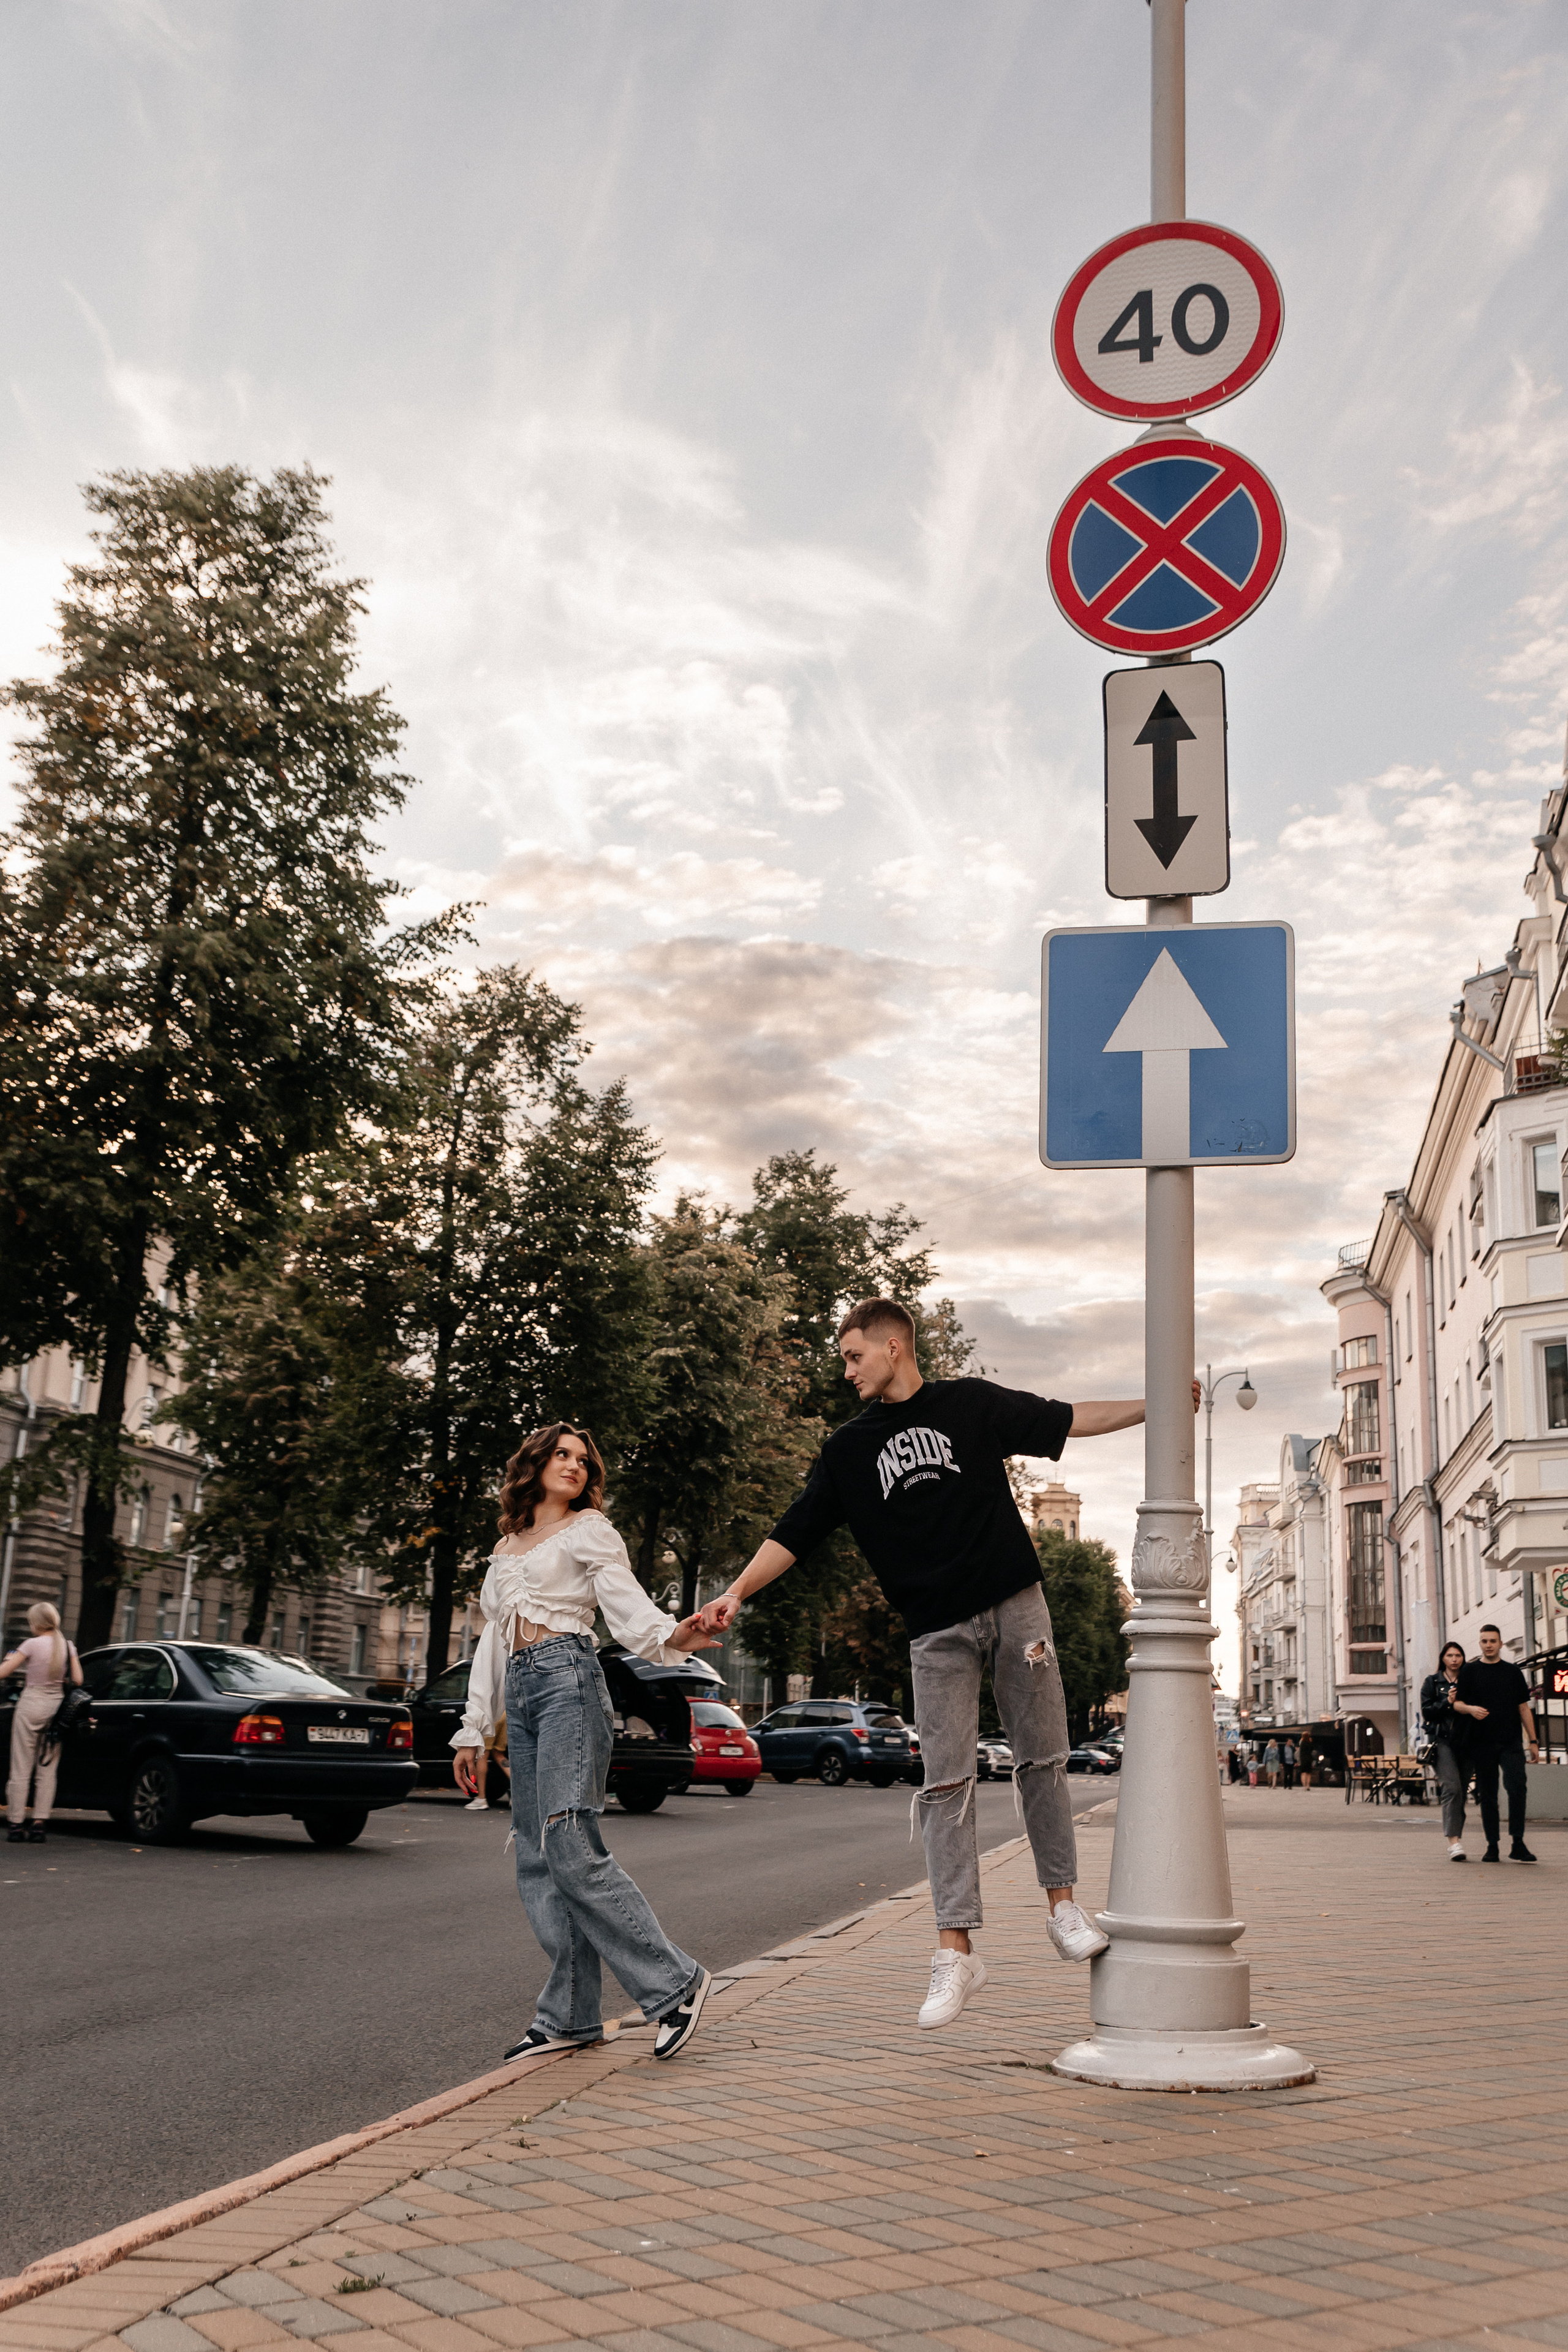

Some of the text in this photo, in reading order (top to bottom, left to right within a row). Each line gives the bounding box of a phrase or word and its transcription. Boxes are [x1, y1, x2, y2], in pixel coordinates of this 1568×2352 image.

[1098, 283, 1229, 364] 40
[876, 1427, 961, 1500] INSIDE
[903, 1472, 940, 1490] STREETWEAR
